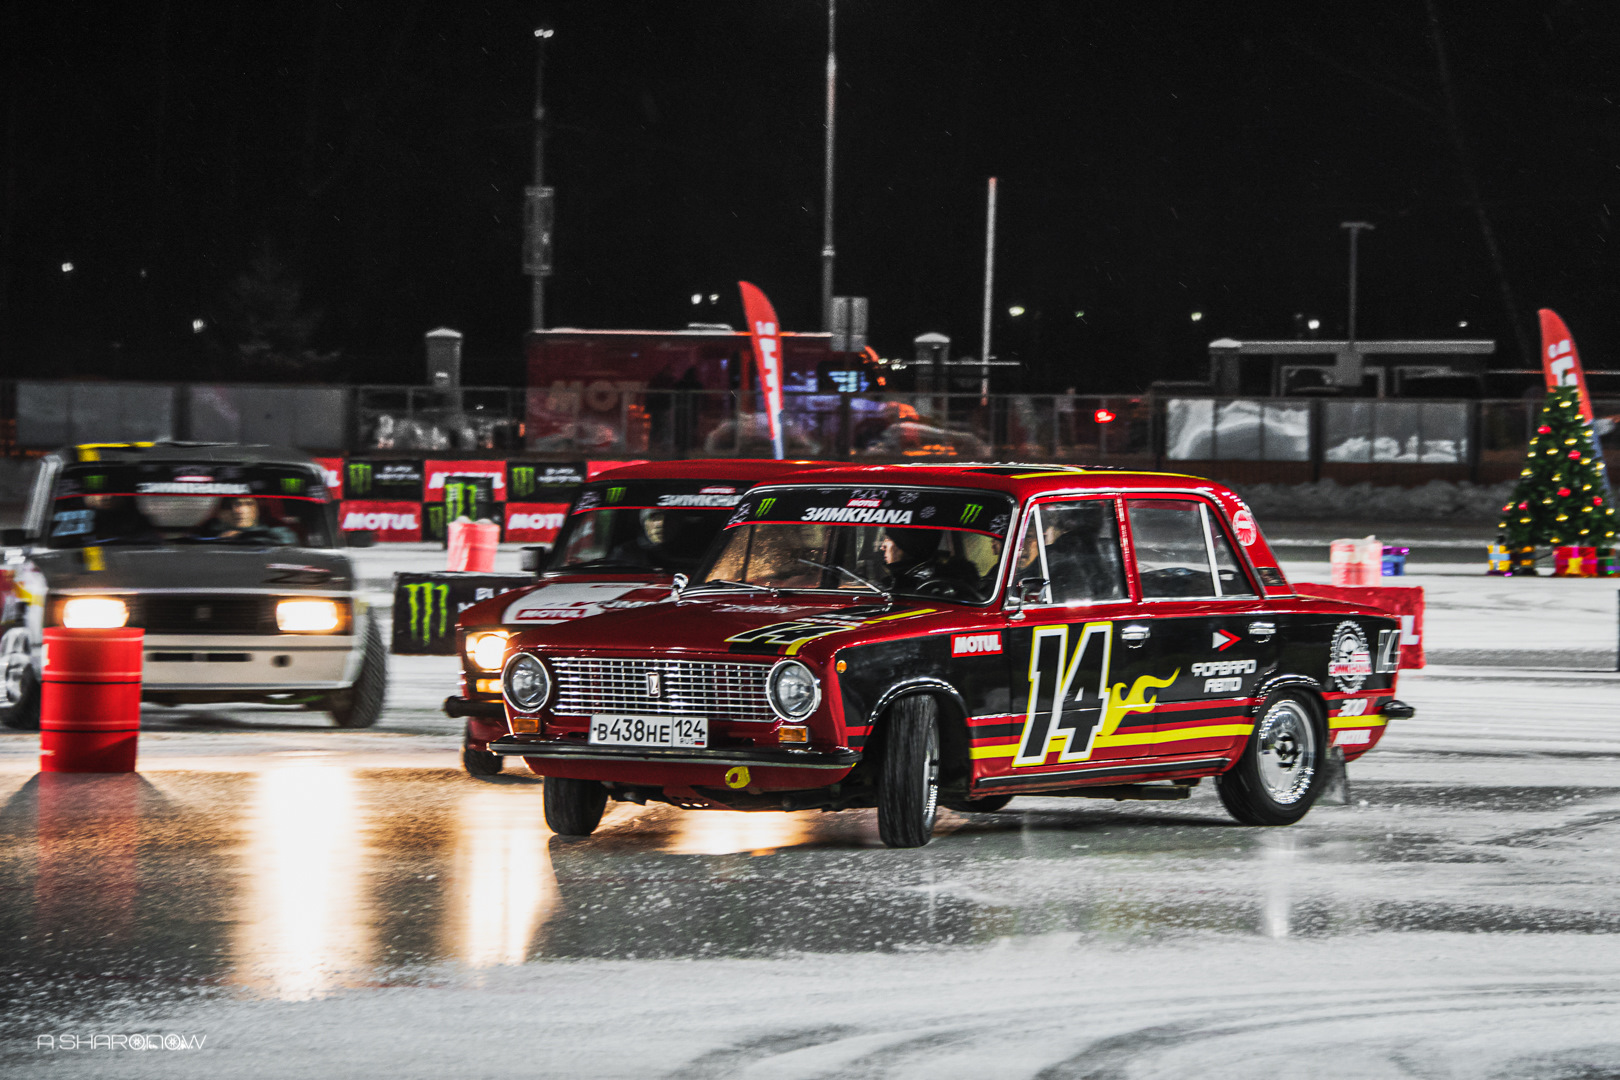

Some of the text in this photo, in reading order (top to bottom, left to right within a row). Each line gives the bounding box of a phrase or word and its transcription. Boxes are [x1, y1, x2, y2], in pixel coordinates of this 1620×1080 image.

[342, 512, 419, 530] MOTUL
[507, 513, 565, 530] MOT
[953, 634, 1001, 654] MOTUL
[1012, 621, 1114, 767] 14
[674, 719, 706, 738] 124
